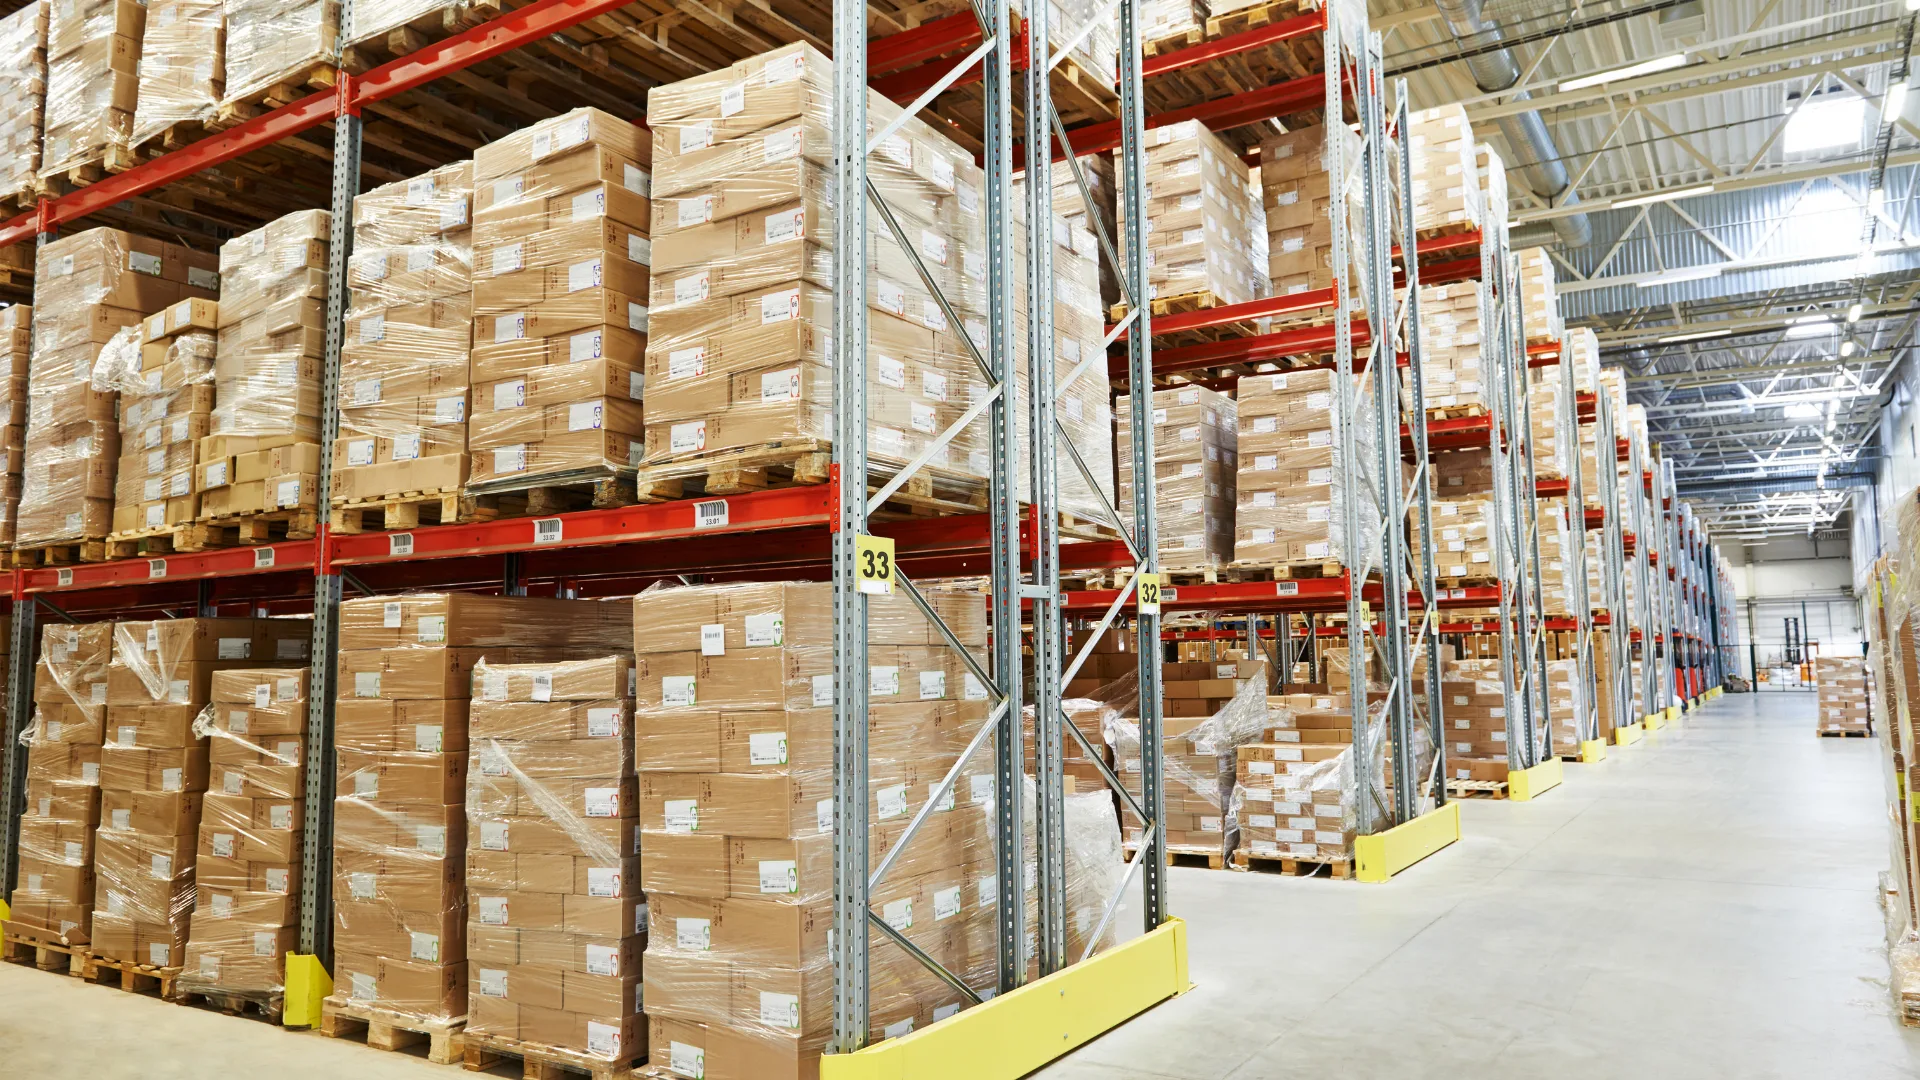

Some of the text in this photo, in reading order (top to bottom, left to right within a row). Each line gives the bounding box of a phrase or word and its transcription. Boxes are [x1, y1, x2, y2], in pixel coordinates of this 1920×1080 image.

[706, 518, 720, 526] 33.01
[862, 549, 890, 580] 33
[884, 583, 889, 593] L
[1142, 582, 1158, 604] 32
